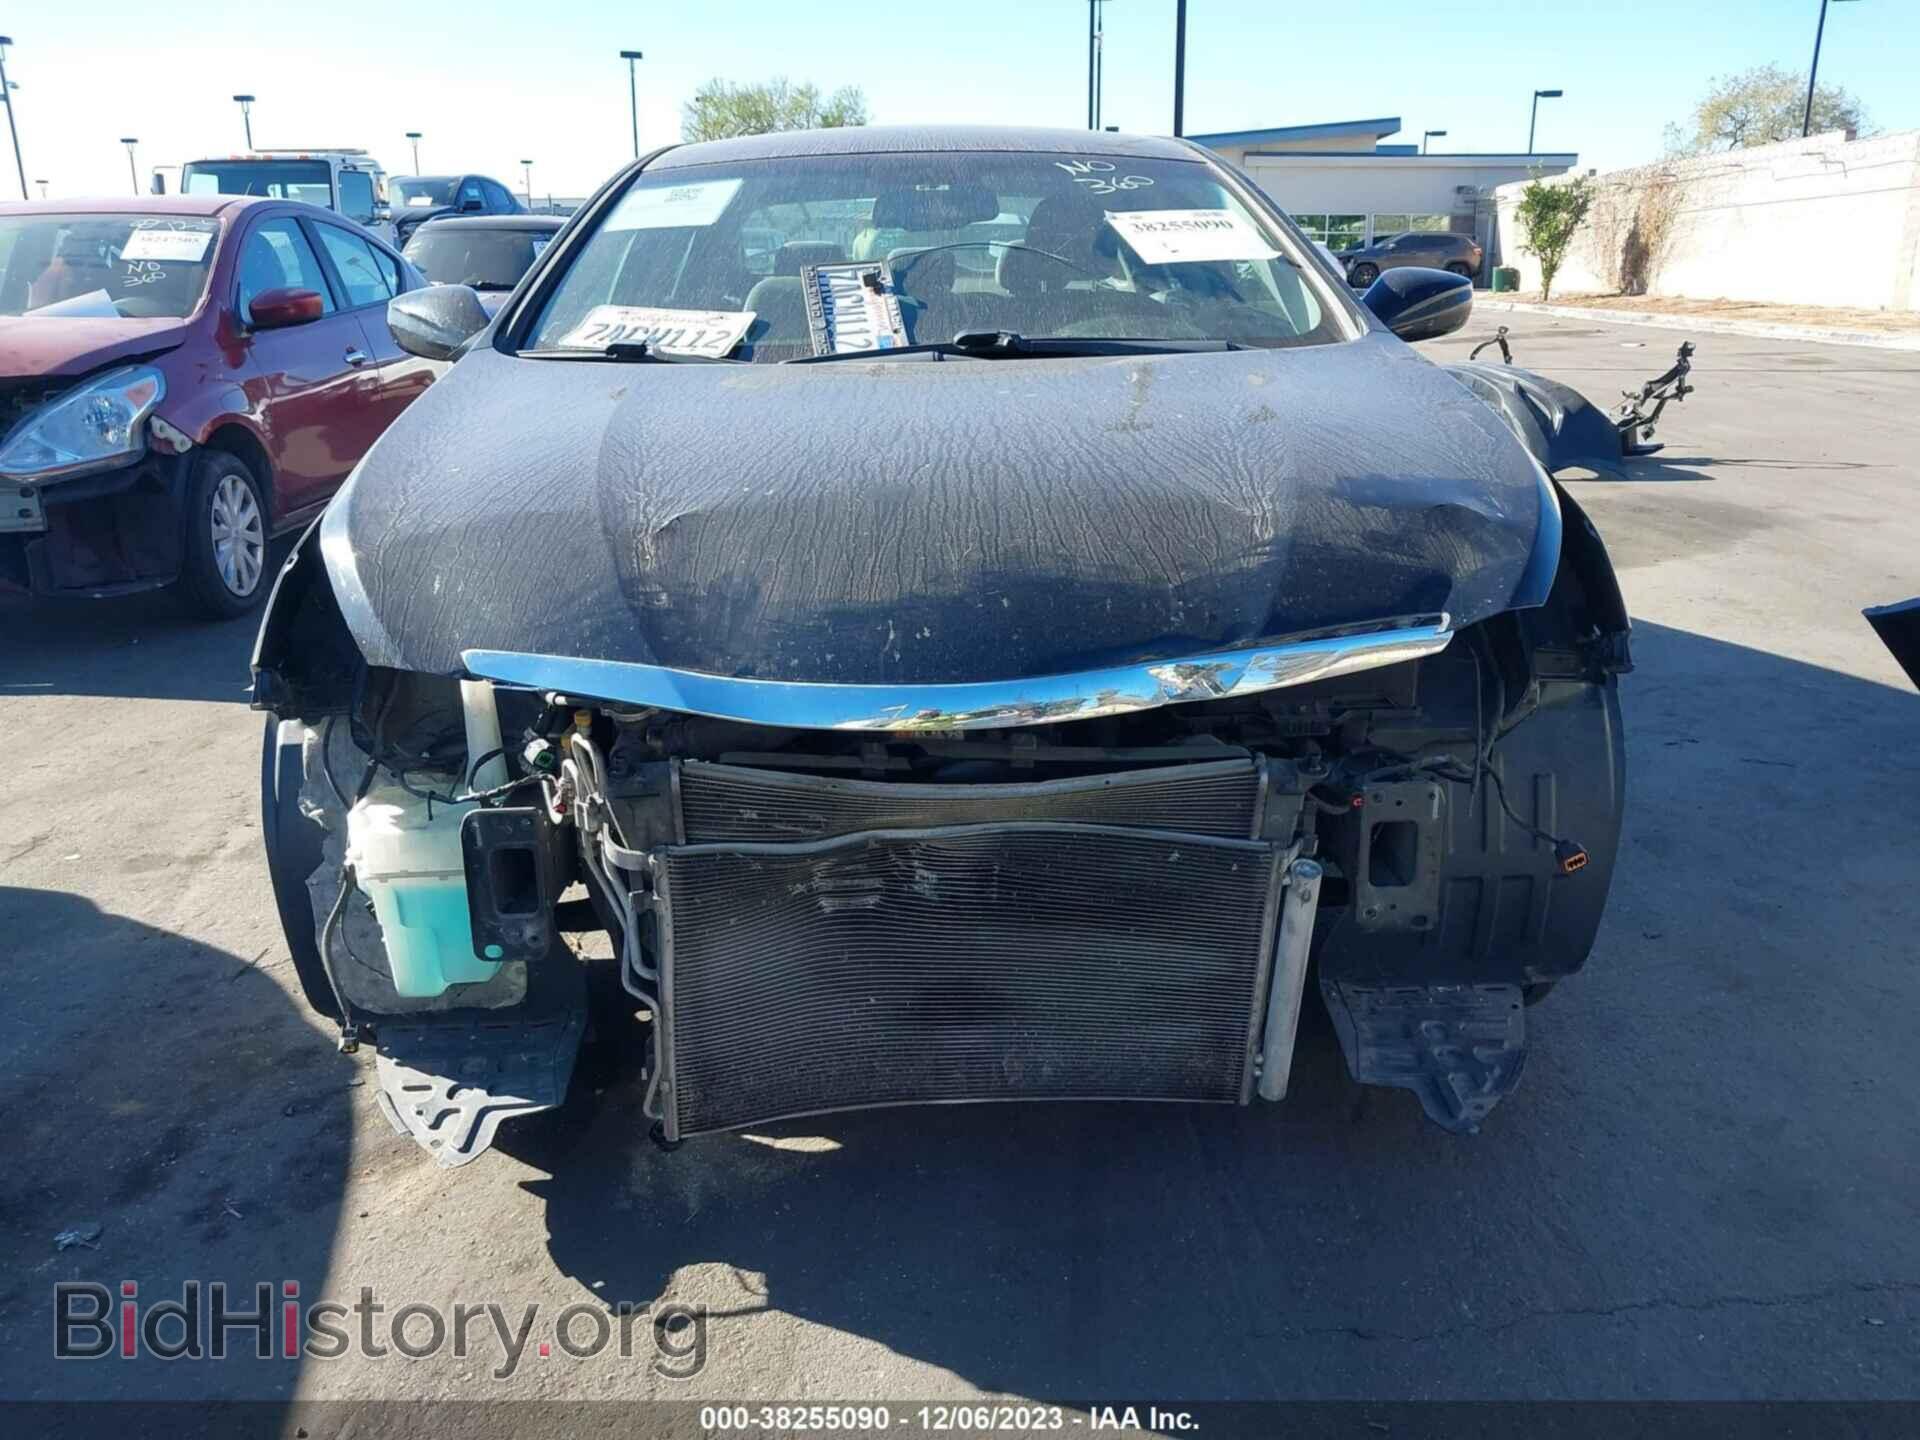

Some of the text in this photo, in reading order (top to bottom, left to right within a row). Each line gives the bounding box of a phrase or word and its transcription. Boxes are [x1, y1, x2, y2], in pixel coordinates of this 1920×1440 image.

[1053, 160, 1116, 176] NO
[1073, 175, 1155, 195] 360
[1130, 219, 1233, 233] 38255090
[127, 260, 160, 274] NO
[121, 271, 166, 287] 360
